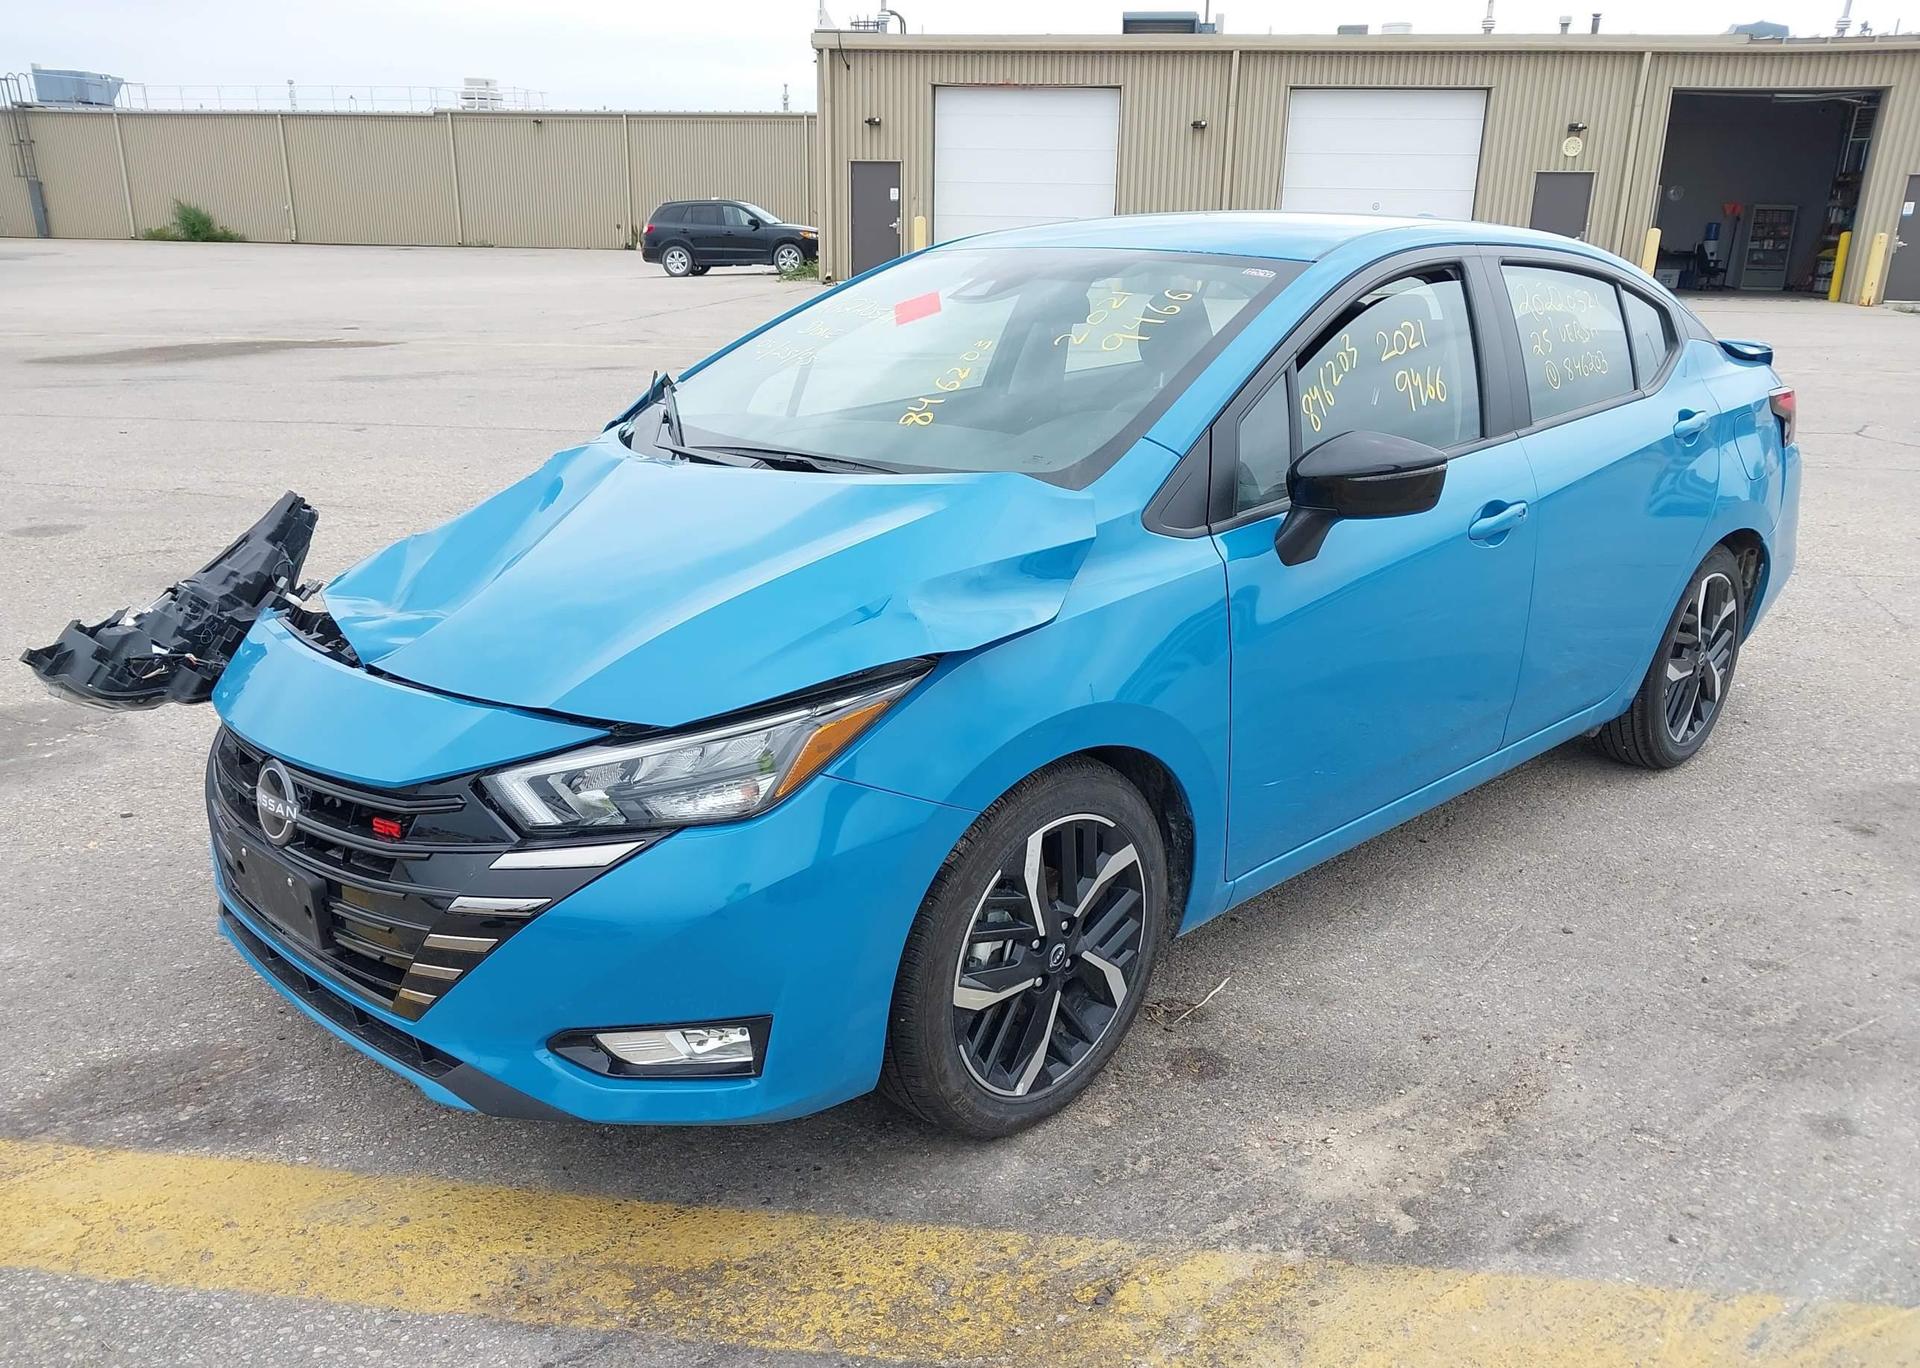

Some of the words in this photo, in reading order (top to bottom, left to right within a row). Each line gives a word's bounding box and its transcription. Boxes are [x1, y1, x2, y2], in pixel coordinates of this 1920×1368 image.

[1053, 290, 1134, 346] 2021
[1101, 288, 1194, 351] 9466
[1375, 319, 1428, 362] 2021
[1301, 333, 1358, 432] 846203
[1395, 365, 1448, 412] 9466
[1562, 350, 1609, 382] 846203
[372, 815, 401, 838] SR
